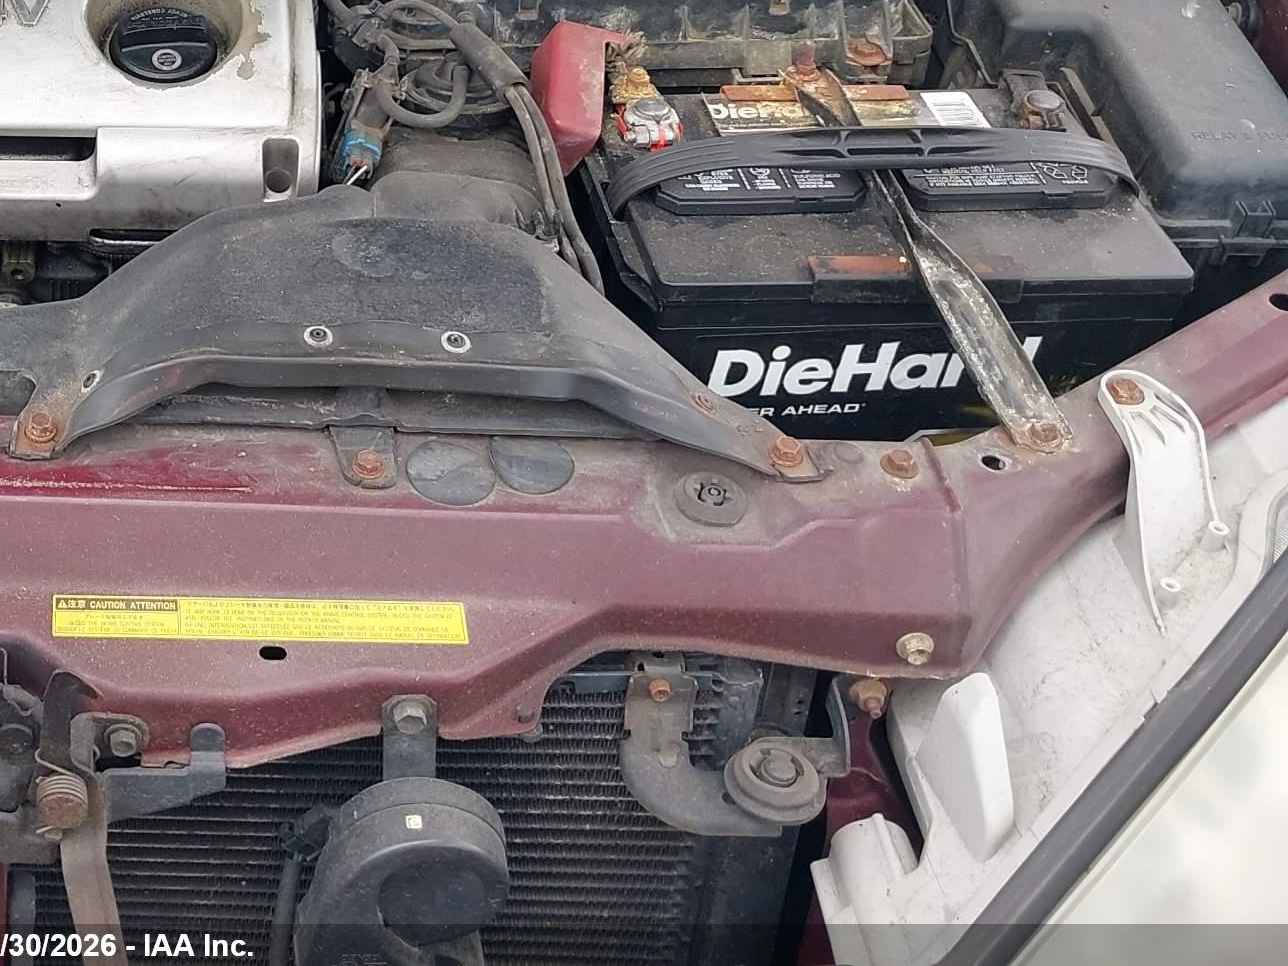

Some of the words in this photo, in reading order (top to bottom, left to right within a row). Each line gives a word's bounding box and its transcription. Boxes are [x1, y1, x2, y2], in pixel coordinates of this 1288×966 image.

[781, 403, 860, 416] AHEAD
[89, 600, 126, 610] CAUTION
[130, 601, 176, 611] ATTENTION
